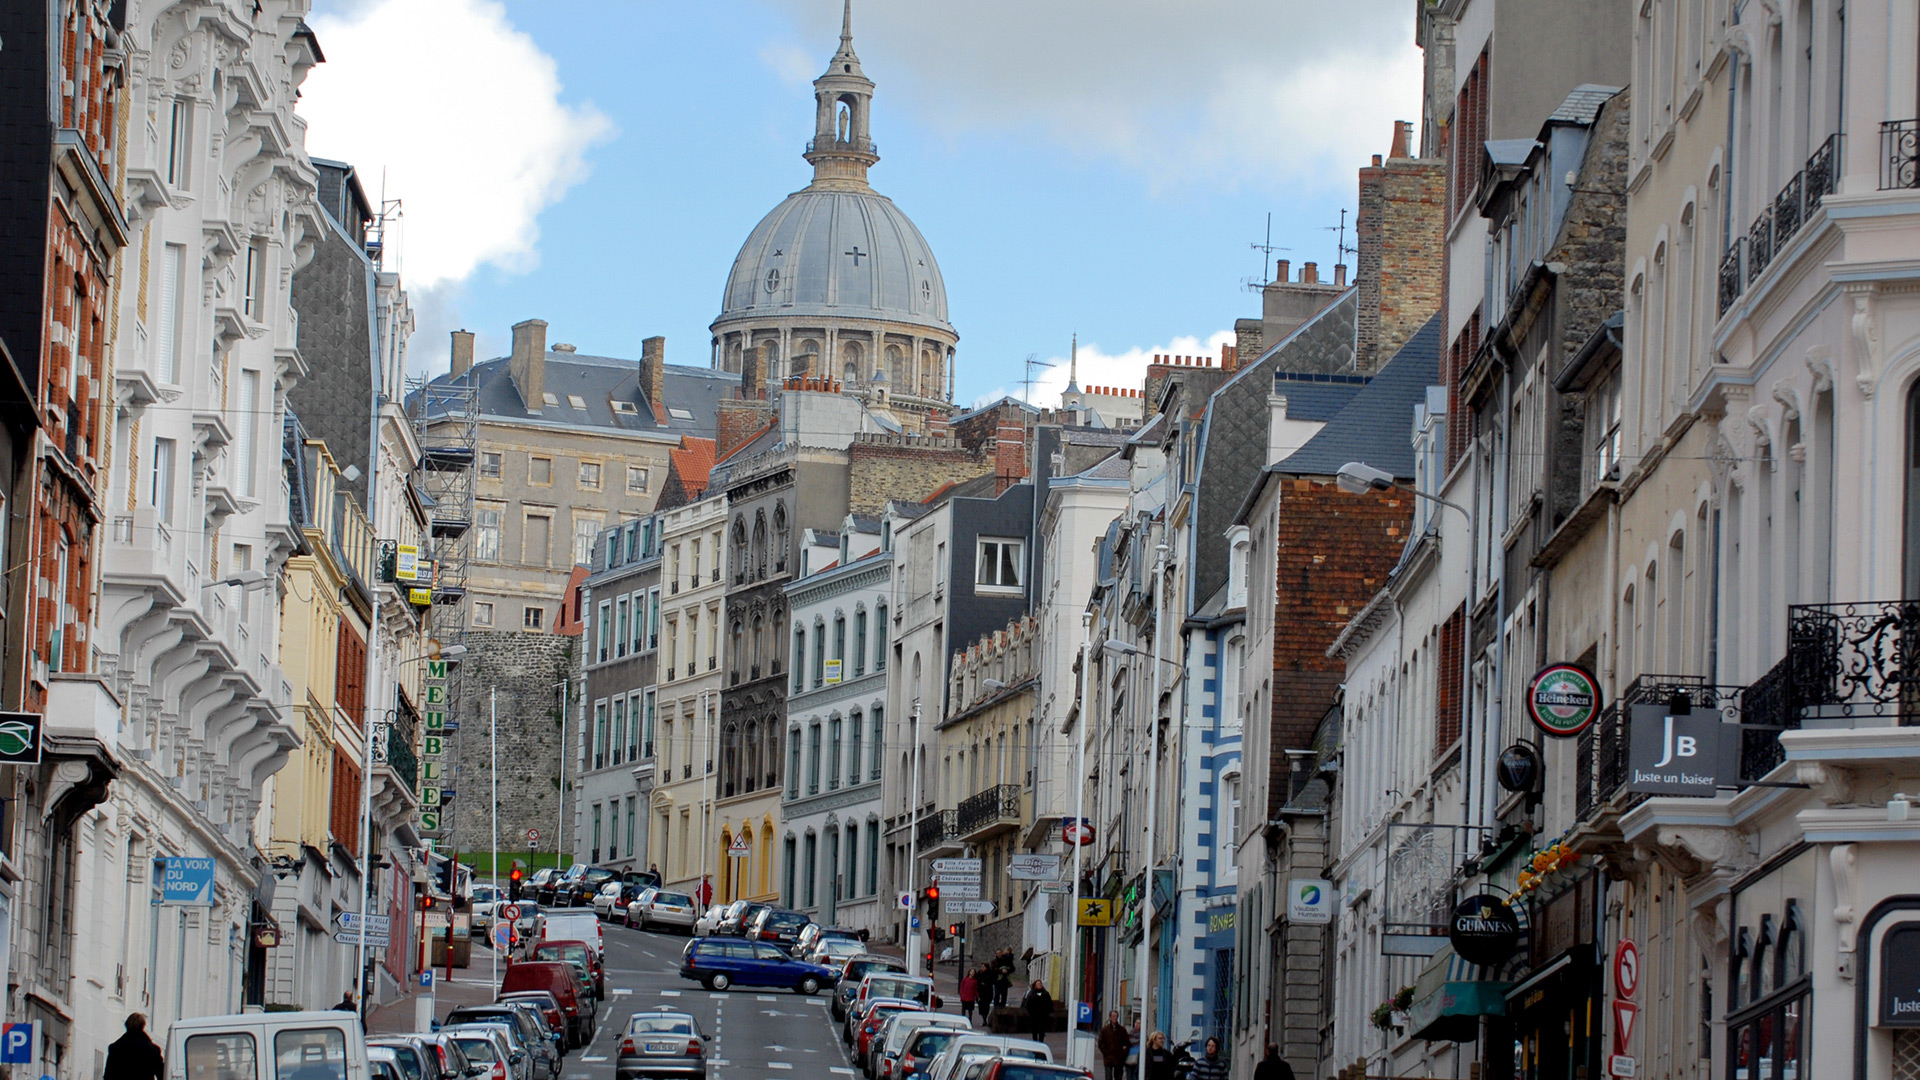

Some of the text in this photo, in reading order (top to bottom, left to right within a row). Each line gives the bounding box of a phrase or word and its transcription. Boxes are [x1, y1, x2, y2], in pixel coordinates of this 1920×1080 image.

[1538, 693, 1589, 705] Heineken
[421, 661, 446, 831] MEUBLES
[1633, 769, 1715, 785] Juste un baiser
[168, 860, 182, 869] LA
[167, 870, 184, 880] DU
[166, 882, 199, 892] NORD
[1456, 917, 1514, 933] GUINNESS
[422, 973, 431, 984] P
[1080, 1006, 1090, 1019] P
[1892, 996, 1920, 1016] Juste
[8, 1030, 28, 1055] P
